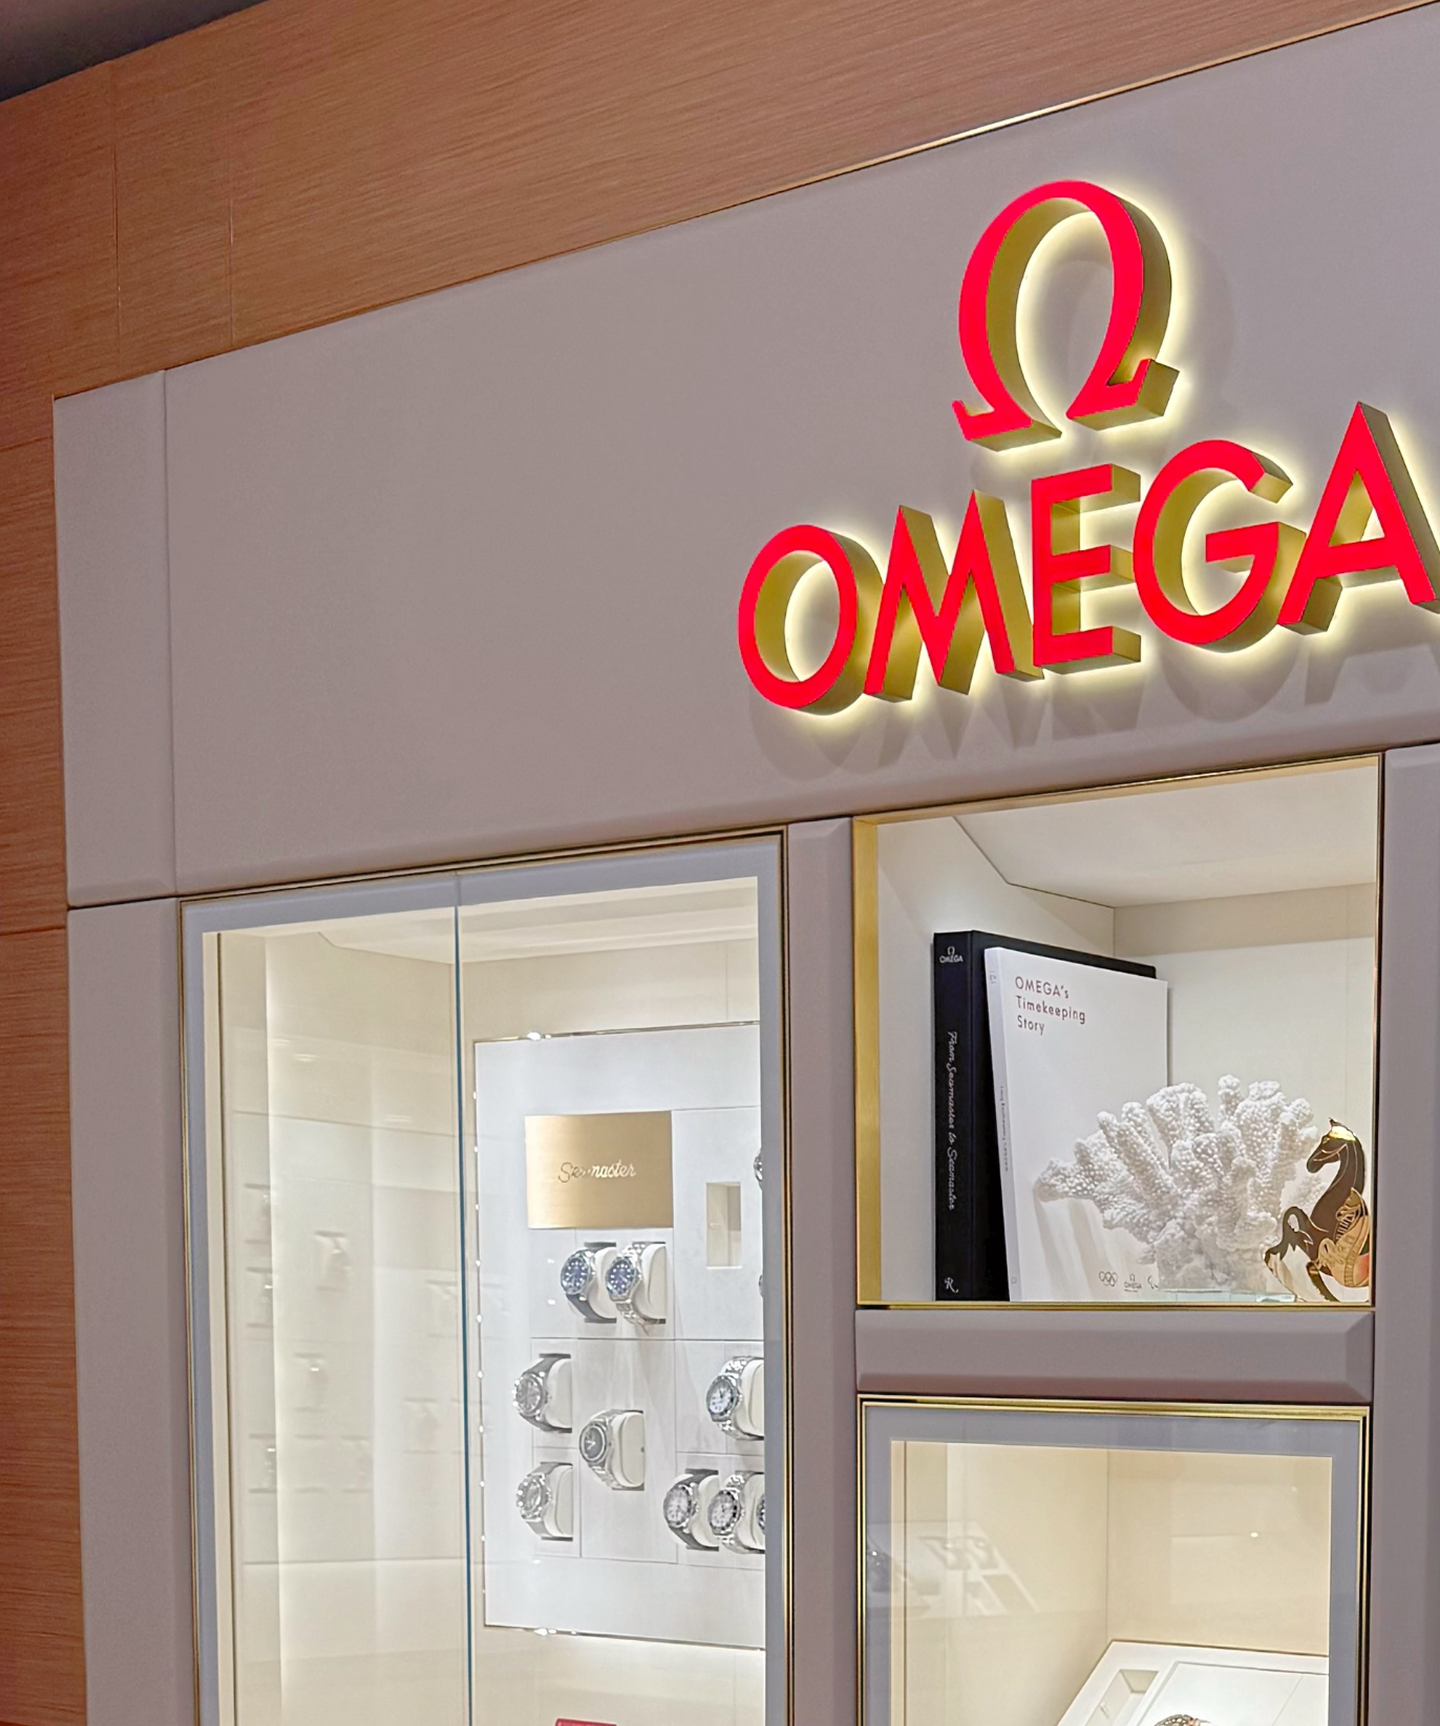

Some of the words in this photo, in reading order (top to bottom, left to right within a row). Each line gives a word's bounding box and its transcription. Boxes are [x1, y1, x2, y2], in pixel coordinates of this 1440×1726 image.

[1015, 976, 1070, 999] OMEGA's
[1016, 995, 1085, 1024] Timekeeping
[1017, 1015, 1045, 1035] Story
